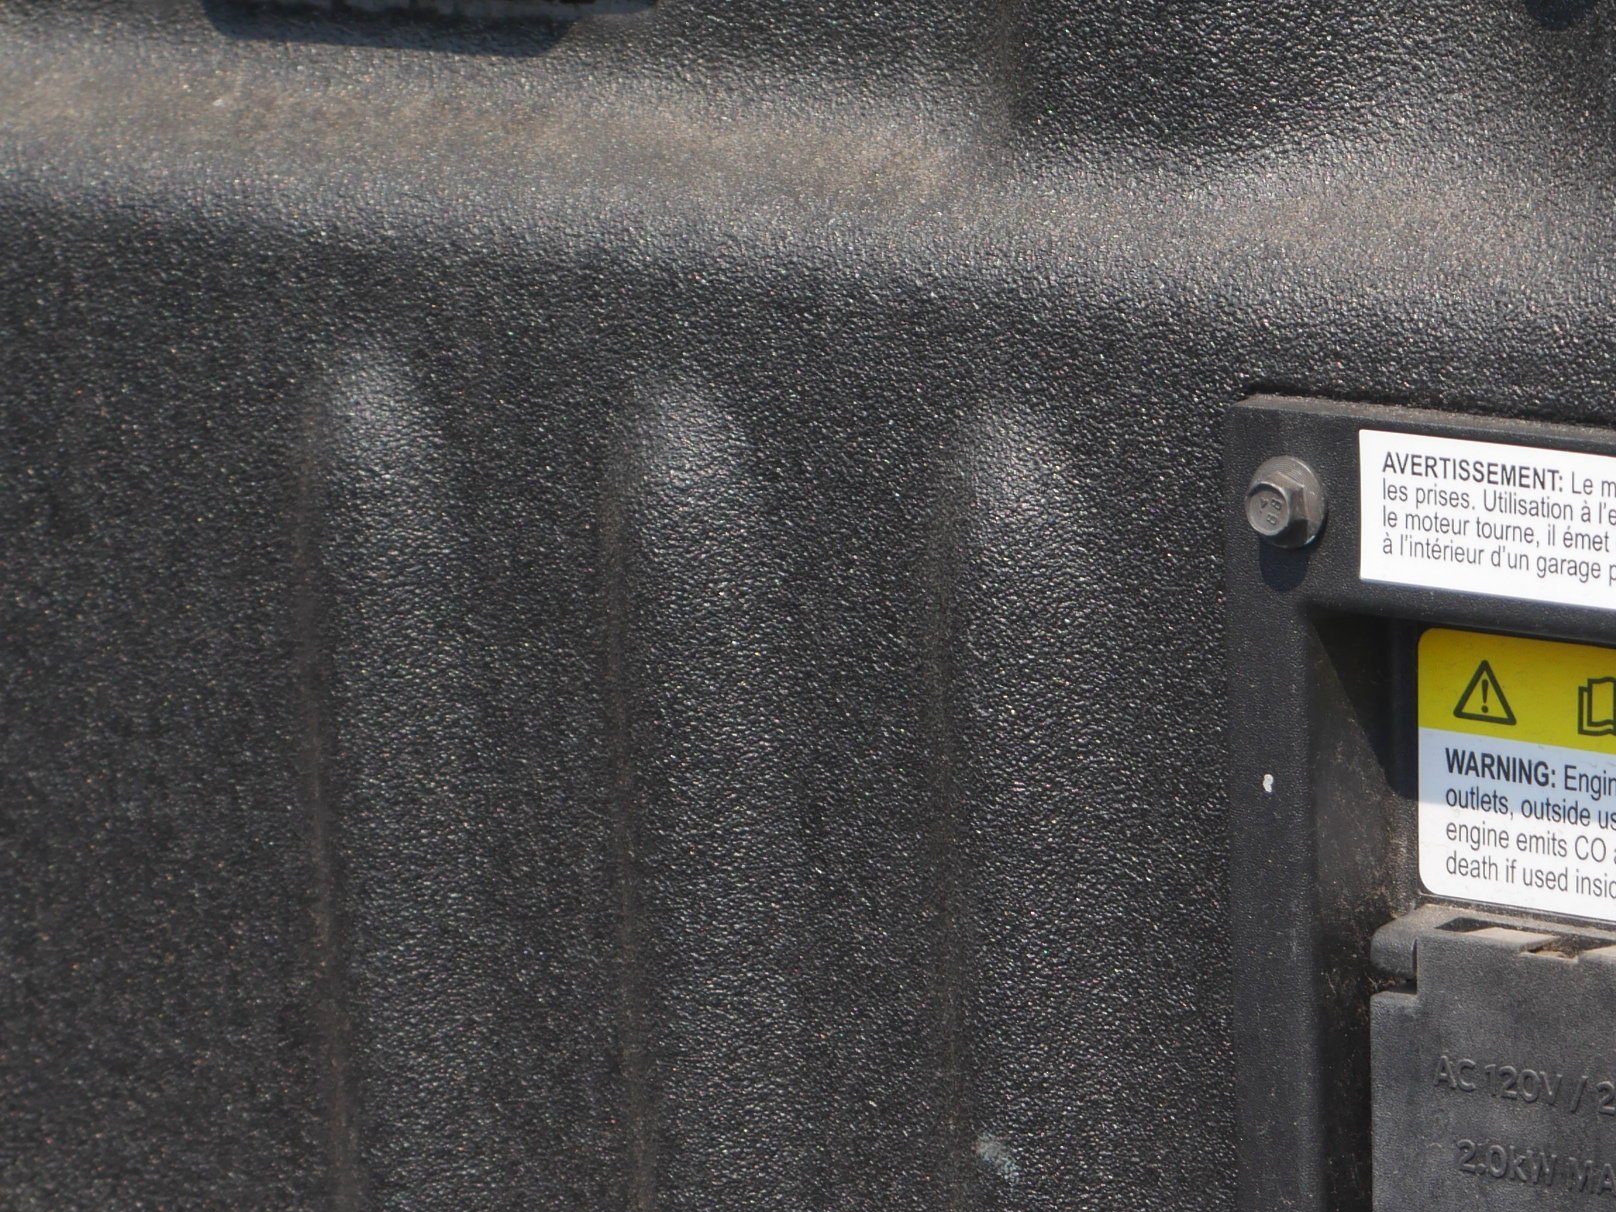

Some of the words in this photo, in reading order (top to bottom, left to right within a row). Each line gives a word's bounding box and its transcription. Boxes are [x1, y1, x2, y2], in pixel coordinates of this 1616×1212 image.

[1382, 451, 1563, 492] AVERTISSEMENT:
[1571, 471, 1593, 495] Le
[1383, 478, 1408, 501] les
[1416, 484, 1475, 510] prises.
[1483, 489, 1573, 520] Utilisation
[1581, 500, 1591, 523] à
[1383, 505, 1397, 527] le
[1405, 513, 1469, 535] moteur
[1476, 520, 1539, 547] tourne,
[1548, 524, 1555, 545] il
[1563, 525, 1609, 552] émet
[1383, 533, 1392, 554] à
[1400, 535, 1484, 565] l'intérieur
[1491, 545, 1529, 571] d'un
[1536, 555, 1601, 583] garage
[1446, 748, 1555, 788] WARNING:
[1446, 785, 1514, 819] outlets,
[1521, 795, 1590, 827] outside
[1446, 820, 1509, 852] engine
[1516, 832, 1567, 858] emits
[1575, 835, 1606, 863] CO
[1446, 851, 1498, 881] death
[1506, 860, 1515, 884] if
[1522, 862, 1568, 891] used
[1433, 1055, 1476, 1092] AC
[1484, 1063, 1562, 1107] 120V
